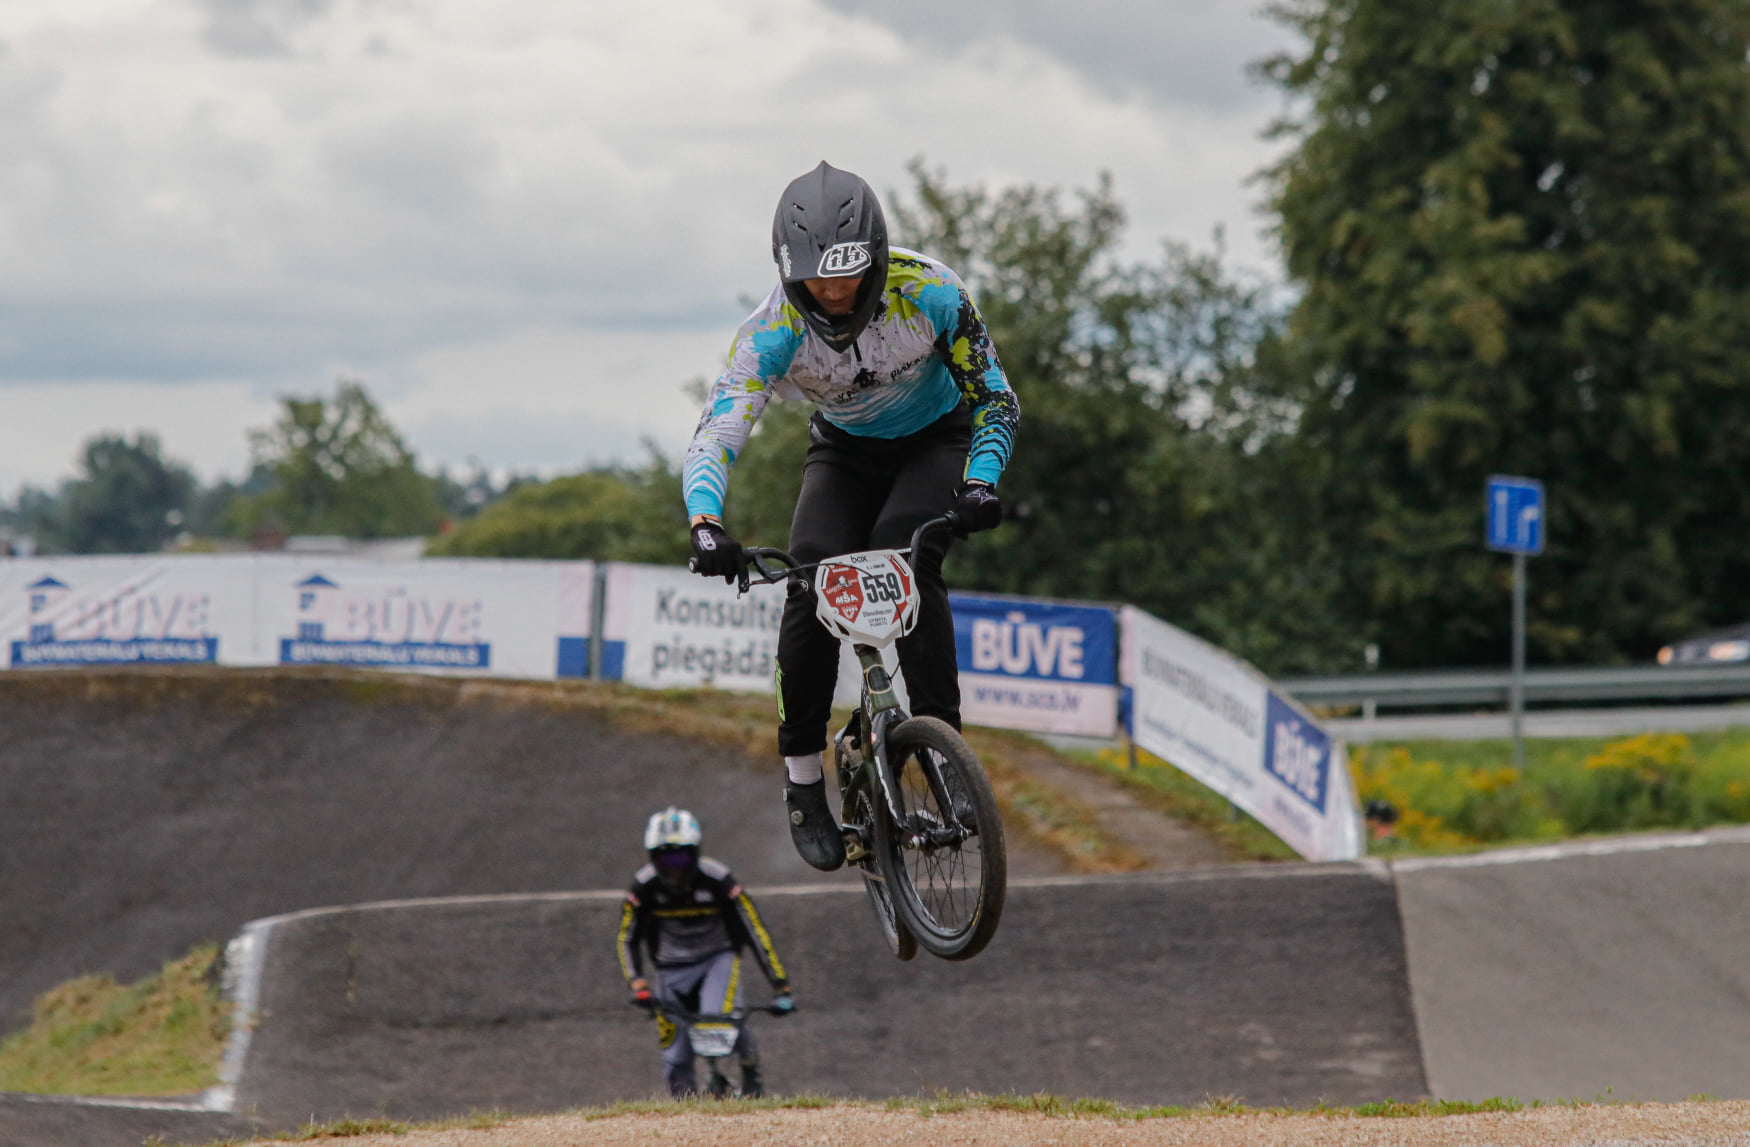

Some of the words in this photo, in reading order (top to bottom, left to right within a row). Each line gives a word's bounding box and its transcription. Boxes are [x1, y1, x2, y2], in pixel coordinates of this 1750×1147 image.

[850, 555, 869, 564] box
[861, 572, 902, 604] 559
[969, 612, 1086, 678] BŪVE
